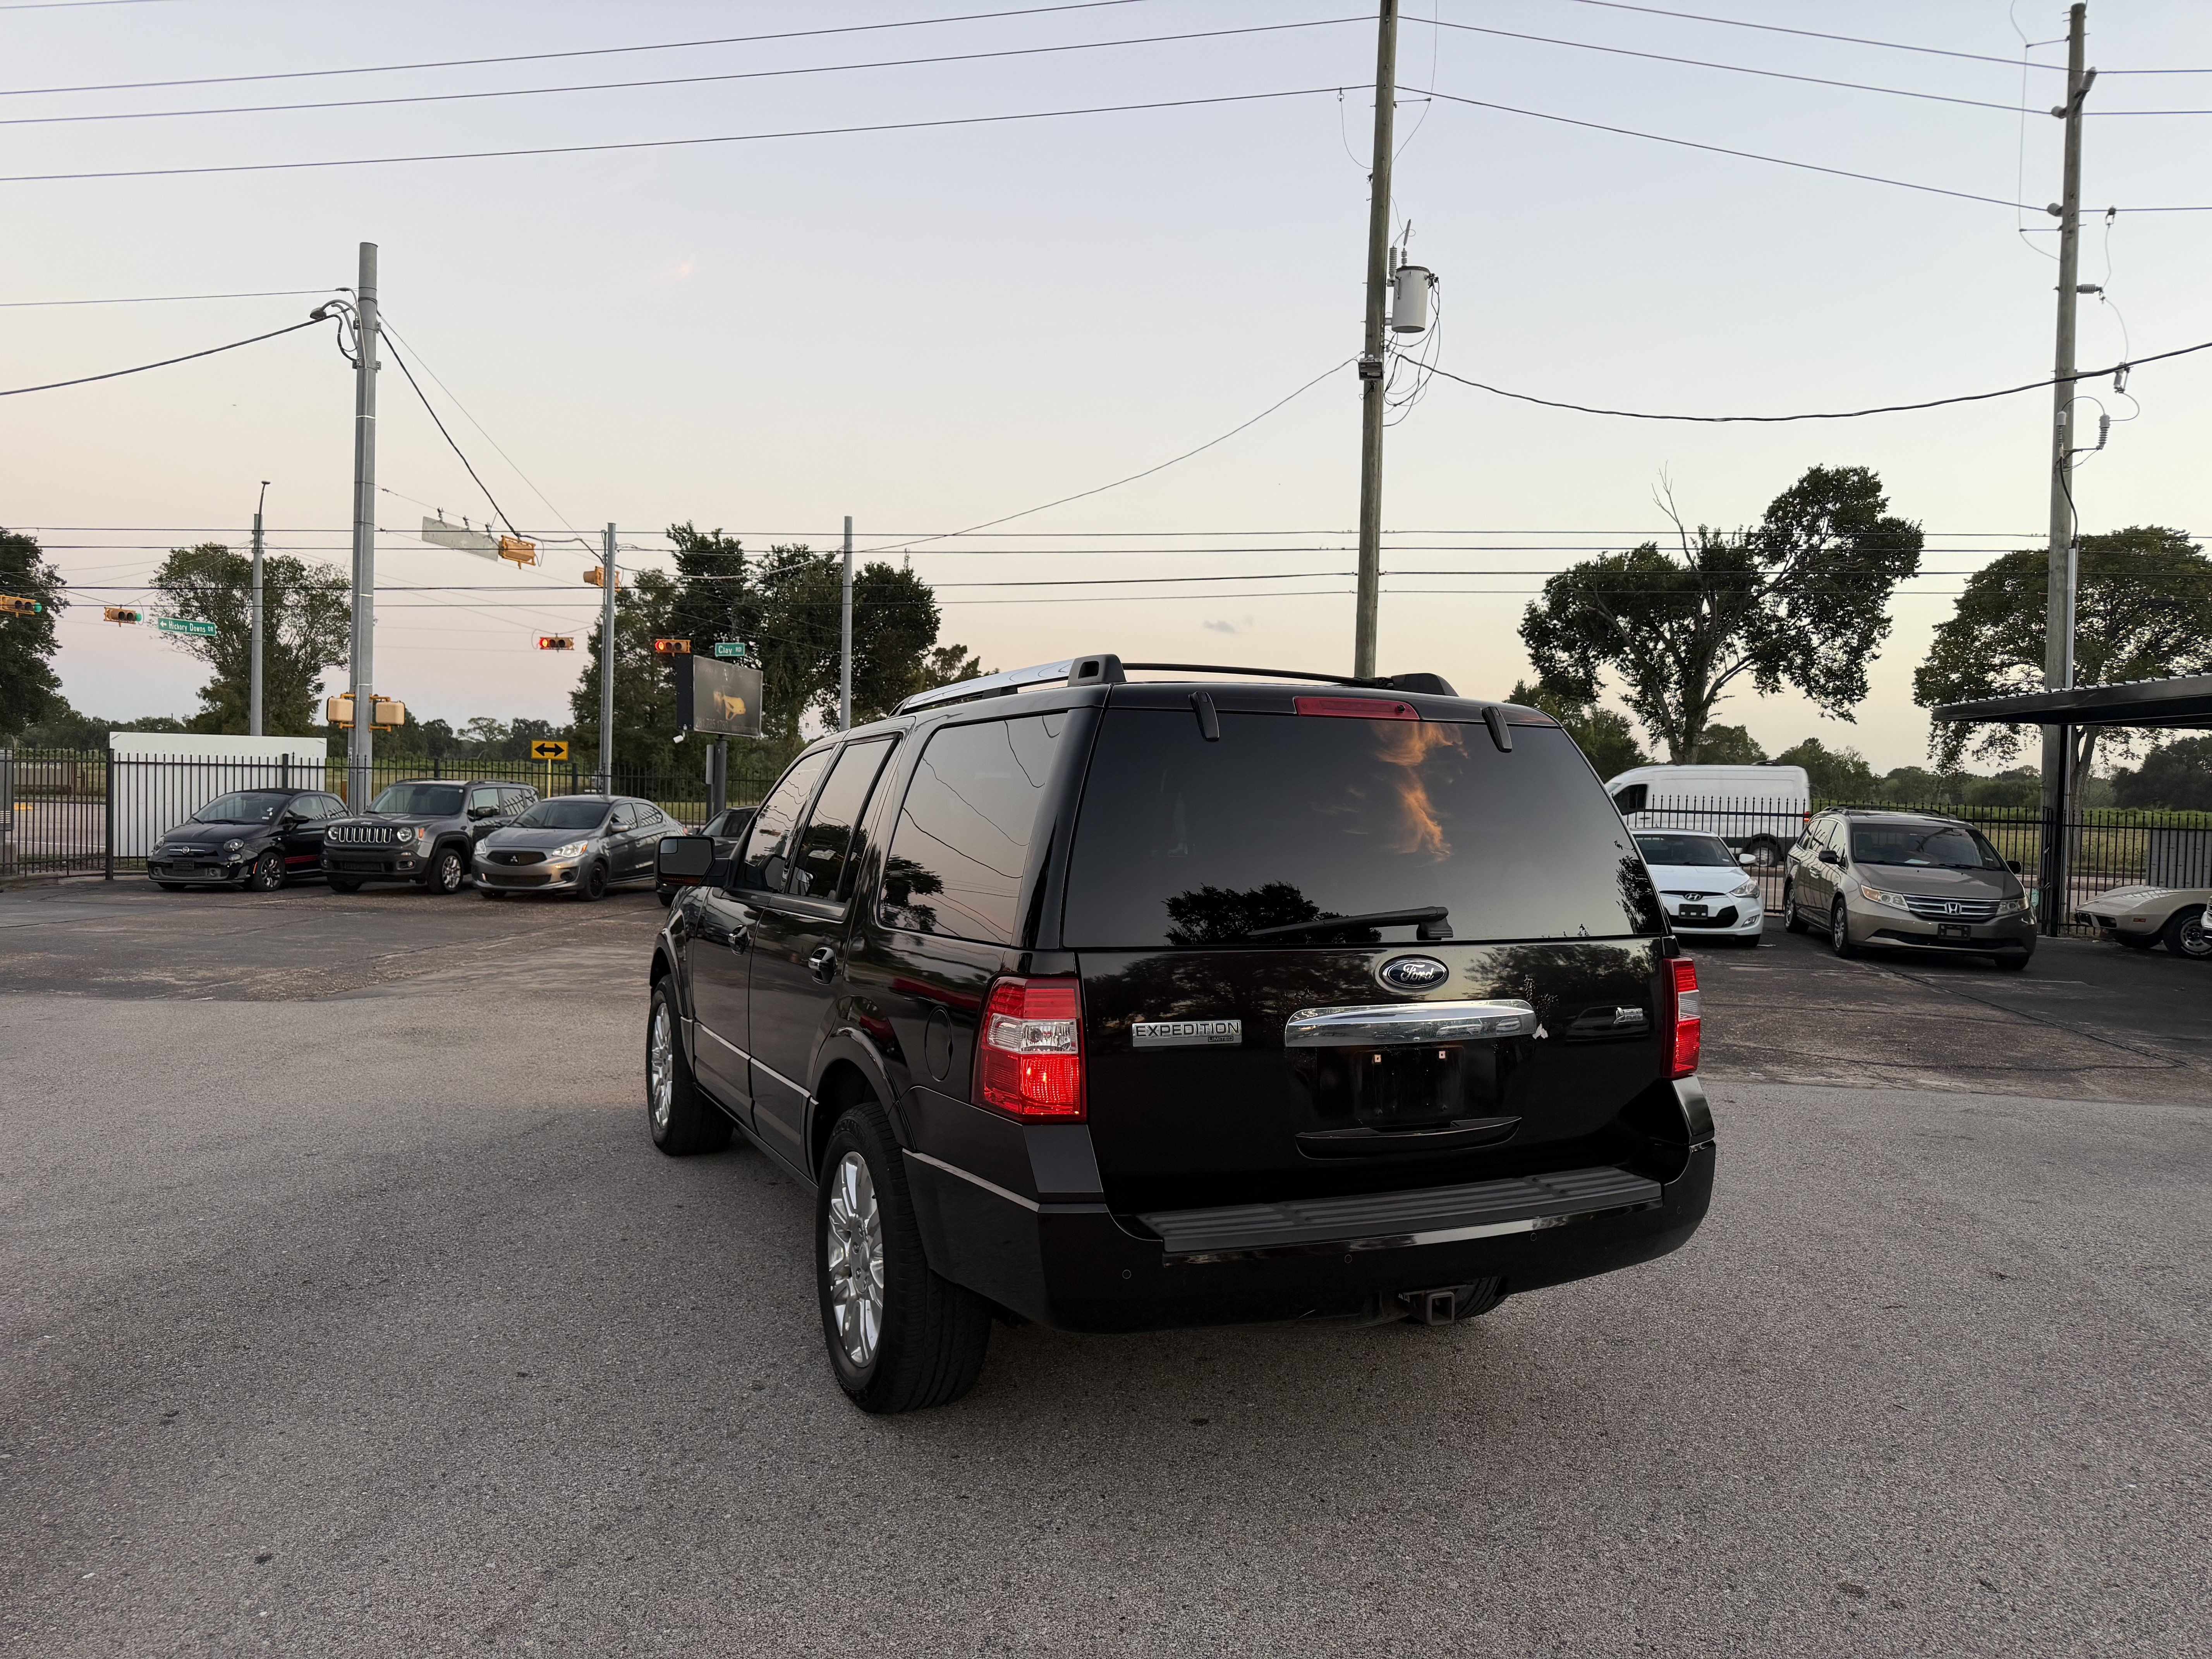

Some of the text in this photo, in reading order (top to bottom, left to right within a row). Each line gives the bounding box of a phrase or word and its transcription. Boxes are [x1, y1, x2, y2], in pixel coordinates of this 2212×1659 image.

[169, 621, 187, 632] Hickory
[190, 623, 206, 632] Downs
[718, 645, 732, 655] Clay
[1400, 964, 1434, 981] Ford
[1136, 1022, 1239, 1037] EXPEDITION
